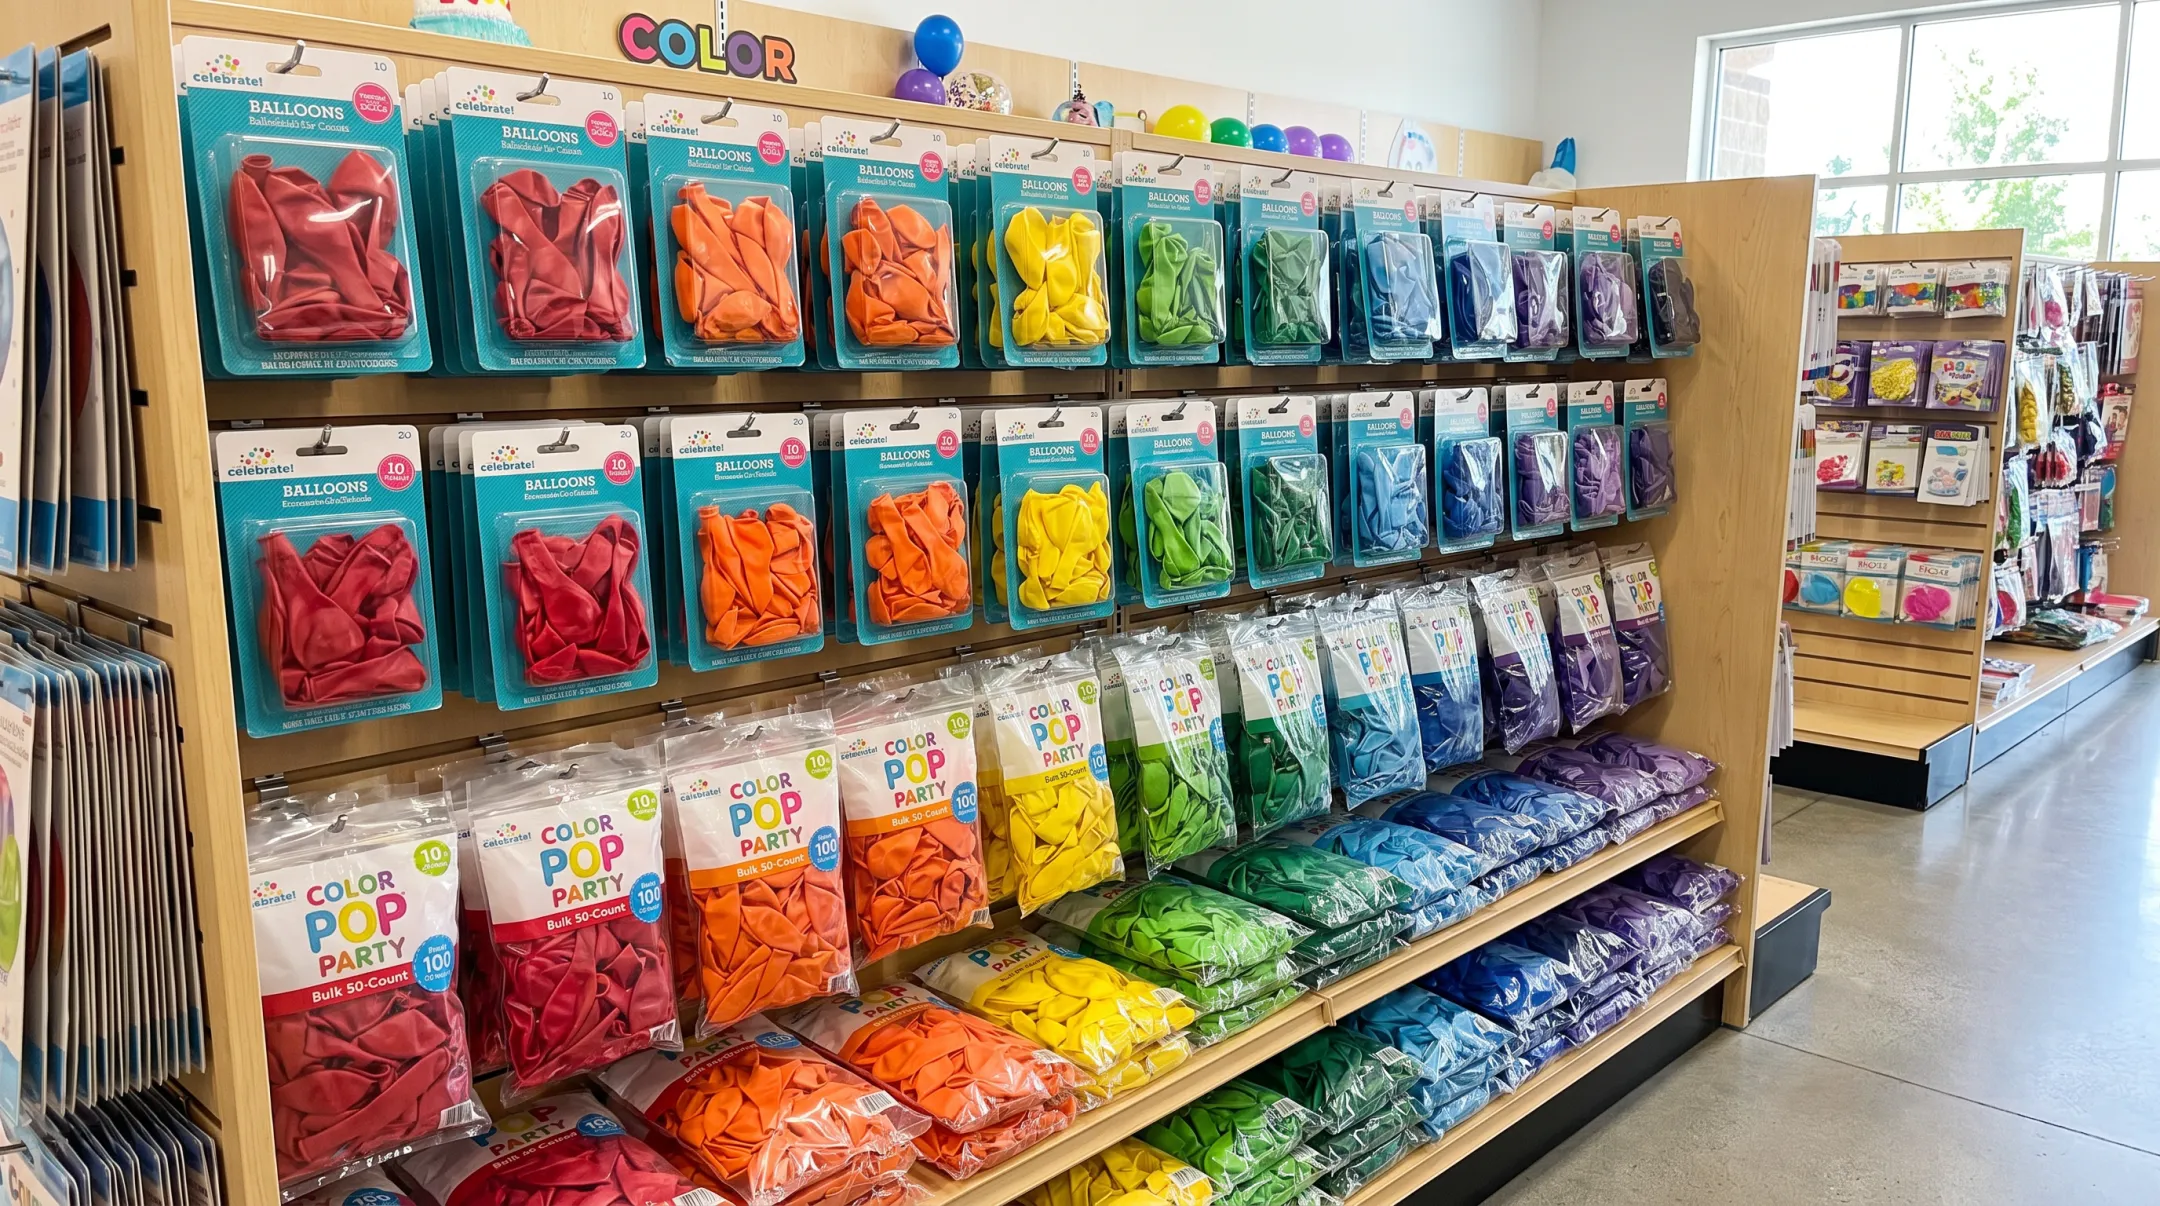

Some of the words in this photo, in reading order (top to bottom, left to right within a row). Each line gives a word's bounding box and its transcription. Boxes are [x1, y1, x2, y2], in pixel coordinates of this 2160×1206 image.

[619, 13, 796, 83] COLOR
[373, 62, 387, 72] 10
[192, 71, 263, 87] celebrate!
[602, 91, 614, 101] 10
[248, 100, 345, 120] BALLOONS
[455, 101, 515, 115] celebrate!
[772, 114, 782, 123] 10
[502, 126, 579, 144] BALLOONS
[650, 123, 699, 136] celebrate!
[932, 134, 941, 142] 10
[688, 146, 752, 163] BALLOONS
[858, 164, 915, 179] BALLOONS
[1022, 180, 1068, 192] BALLOONS
[1148, 192, 1190, 204] BALLOONS
[793, 418, 804, 426] 20
[398, 431, 412, 440] 20
[620, 430, 632, 438] 20
[940, 436, 953, 446] 10
[1084, 433, 1094, 444] 10
[786, 444, 800, 455] 10
[880, 449, 931, 462] BALLOONS
[1030, 446, 1075, 457] BALLOONS
[228, 464, 294, 477] celebrate!
[386, 462, 405, 474] 10
[480, 460, 535, 472] celebrate!
[611, 458, 627, 470] 10
[715, 459, 774, 473] BALLOONS
[282, 480, 368, 498] BALLOONS
[525, 475, 596, 491] BALLOONS
[1629, 581, 1653, 604] POP
[1080, 684, 1093, 696] 10
[1029, 698, 1072, 721] COLOR
[950, 717, 964, 728] 10
[1171, 714, 1206, 736] PARTY
[1030, 714, 1082, 752] POP
[884, 732, 937, 756] COLOR
[809, 754, 826, 768] 10
[1042, 742, 1084, 768] PARTY
[884, 748, 946, 790] POP
[730, 772, 792, 800] COLOR
[894, 780, 946, 808] PARTY
[631, 795, 651, 809] 10
[956, 793, 976, 810] 100
[728, 790, 802, 838] POP
[541, 814, 614, 844] COLOR
[740, 826, 802, 858] PARTY
[814, 838, 838, 858] 100
[420, 846, 442, 864] 10
[540, 834, 624, 887] POP
[736, 864, 758, 878] Bulk
[760, 853, 804, 872] 50-Count
[306, 870, 395, 906] COLOR
[552, 872, 624, 908] PARTY
[637, 886, 661, 904] 100
[305, 893, 407, 954] POP
[546, 916, 572, 931] Bulk
[574, 902, 627, 923] 50-Count
[318, 936, 406, 978] PARTY
[422, 951, 451, 974] 100
[992, 944, 1042, 972] PARTY
[312, 986, 343, 1004] Bulk
[346, 970, 409, 994] 50-Count
[839, 986, 907, 1014] POP
[862, 995, 920, 1018] PARTY
[488, 1120, 566, 1157] PARTY
